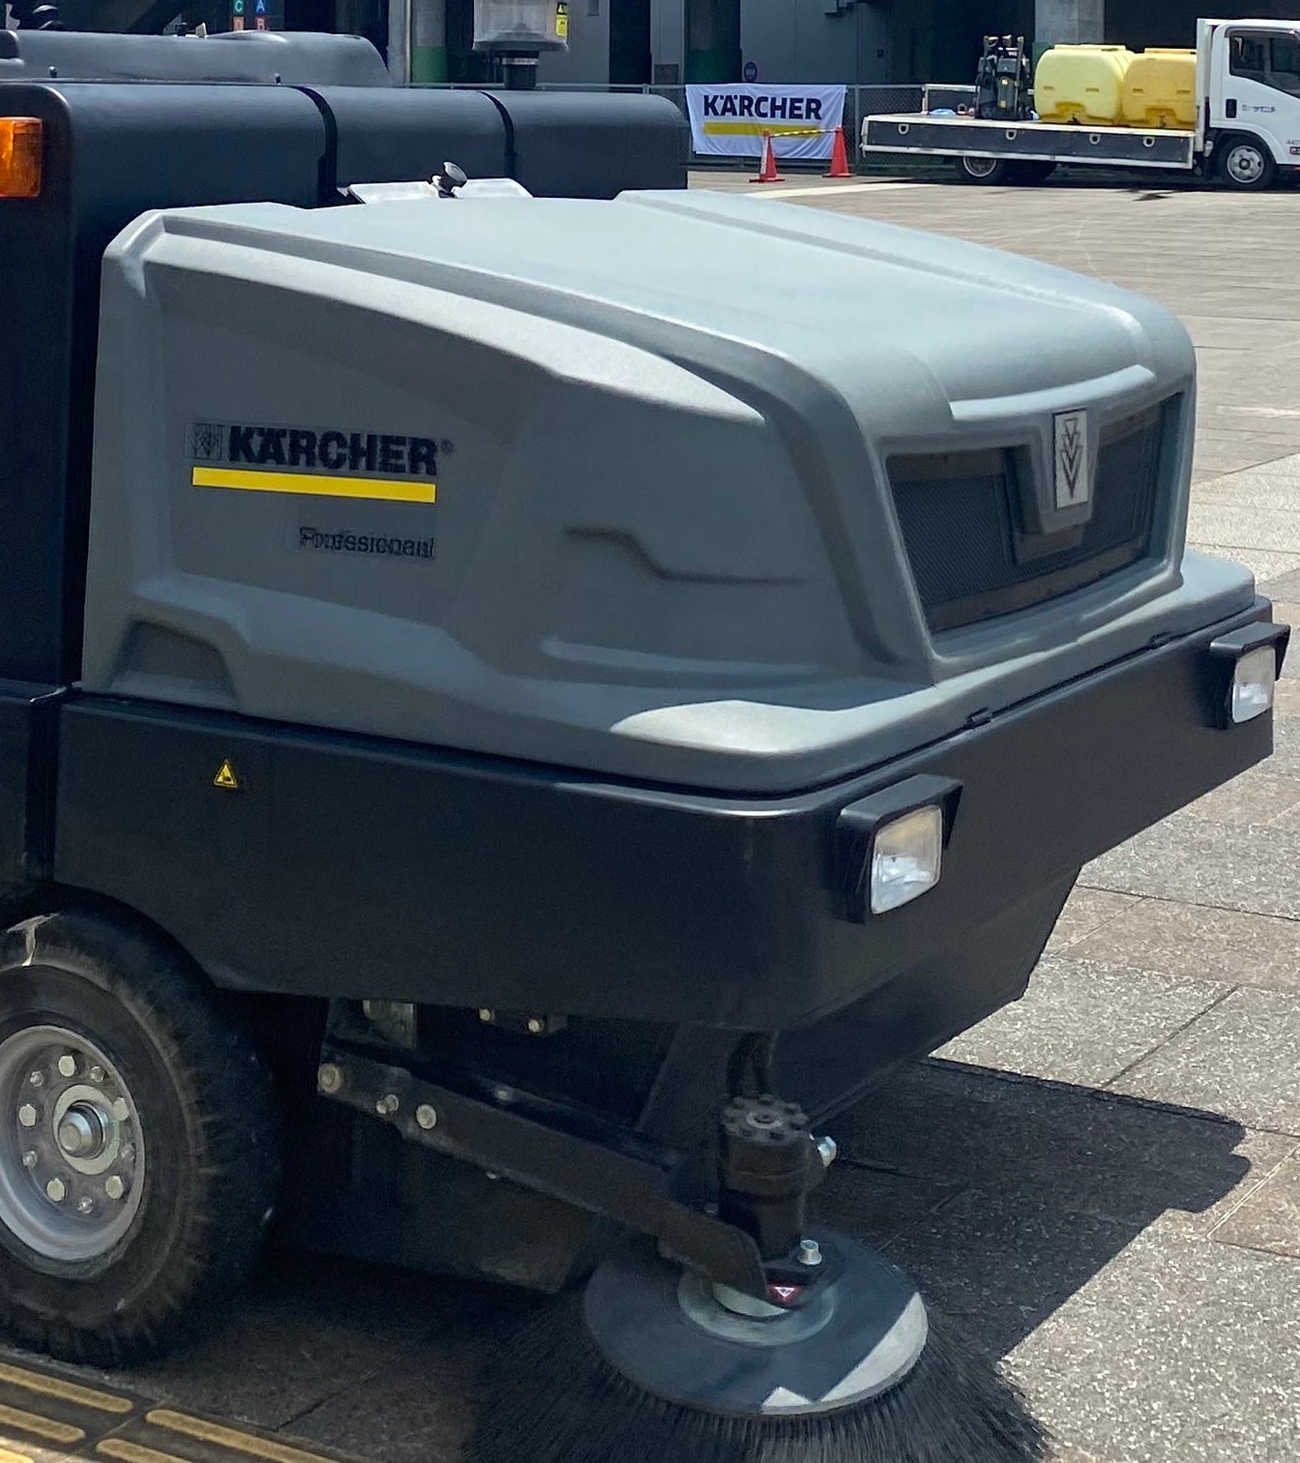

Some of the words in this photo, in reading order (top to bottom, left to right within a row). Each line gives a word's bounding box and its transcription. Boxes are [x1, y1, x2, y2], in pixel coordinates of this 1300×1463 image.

[234, 0, 244, 13] C
[255, 0, 266, 13] A
[703, 94, 822, 120] KÄRCHER
[229, 425, 438, 476] KÄRCHER
